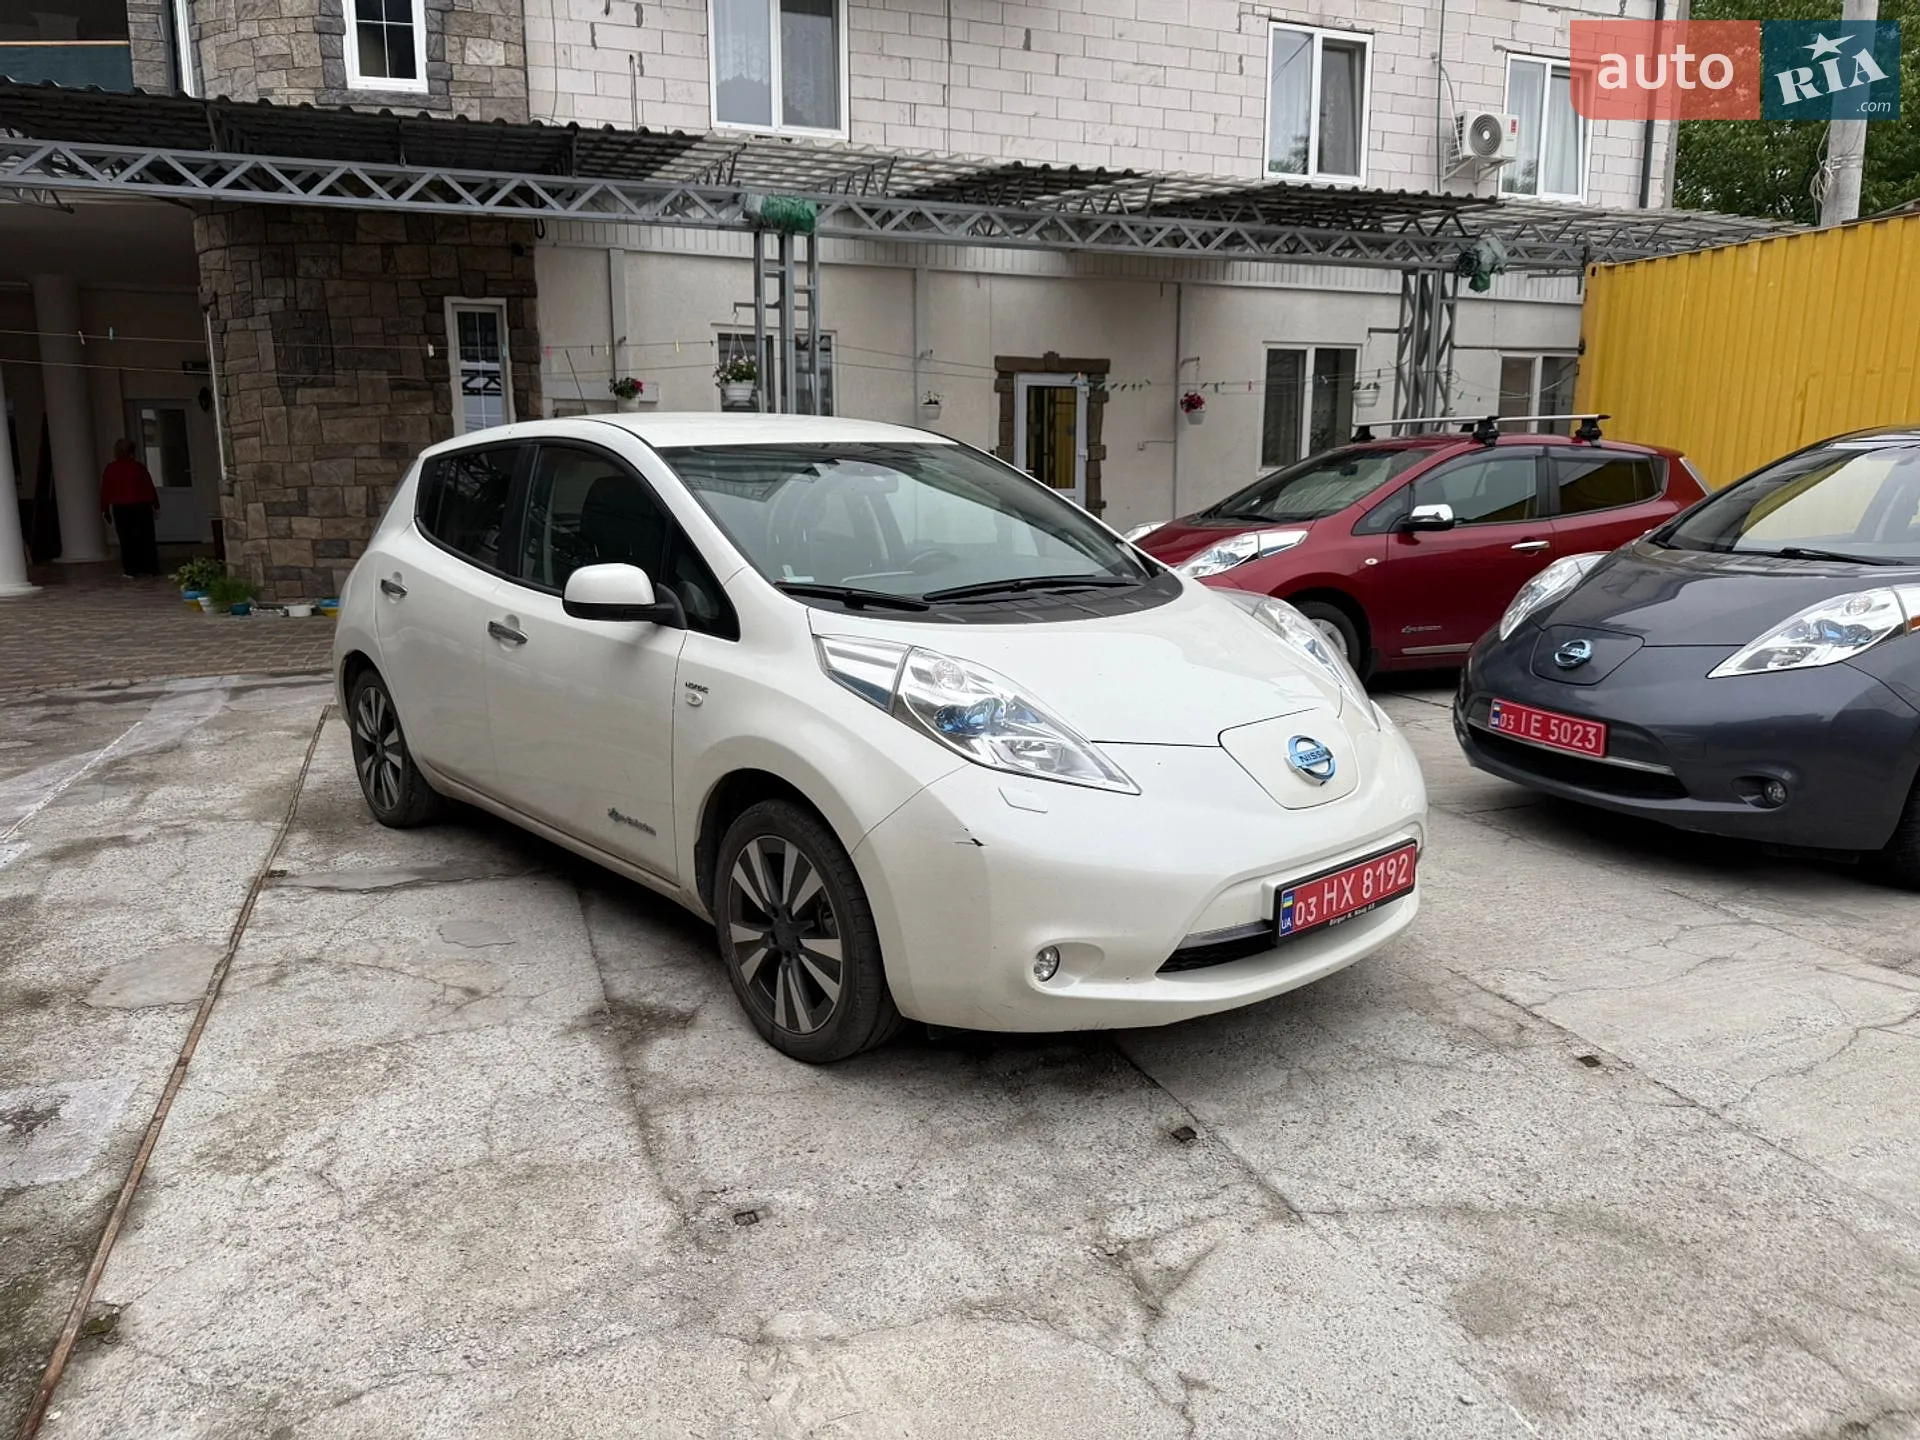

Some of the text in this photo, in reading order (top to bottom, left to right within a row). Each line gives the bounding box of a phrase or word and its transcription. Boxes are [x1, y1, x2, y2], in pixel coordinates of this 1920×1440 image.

[1500, 712, 1597, 749] 03 IE 5023
[1298, 748, 1327, 763] NISS
[1295, 896, 1317, 926] 03
[1323, 873, 1356, 915] HX
[1362, 853, 1409, 899] 8192
[1281, 917, 1292, 930] UA
